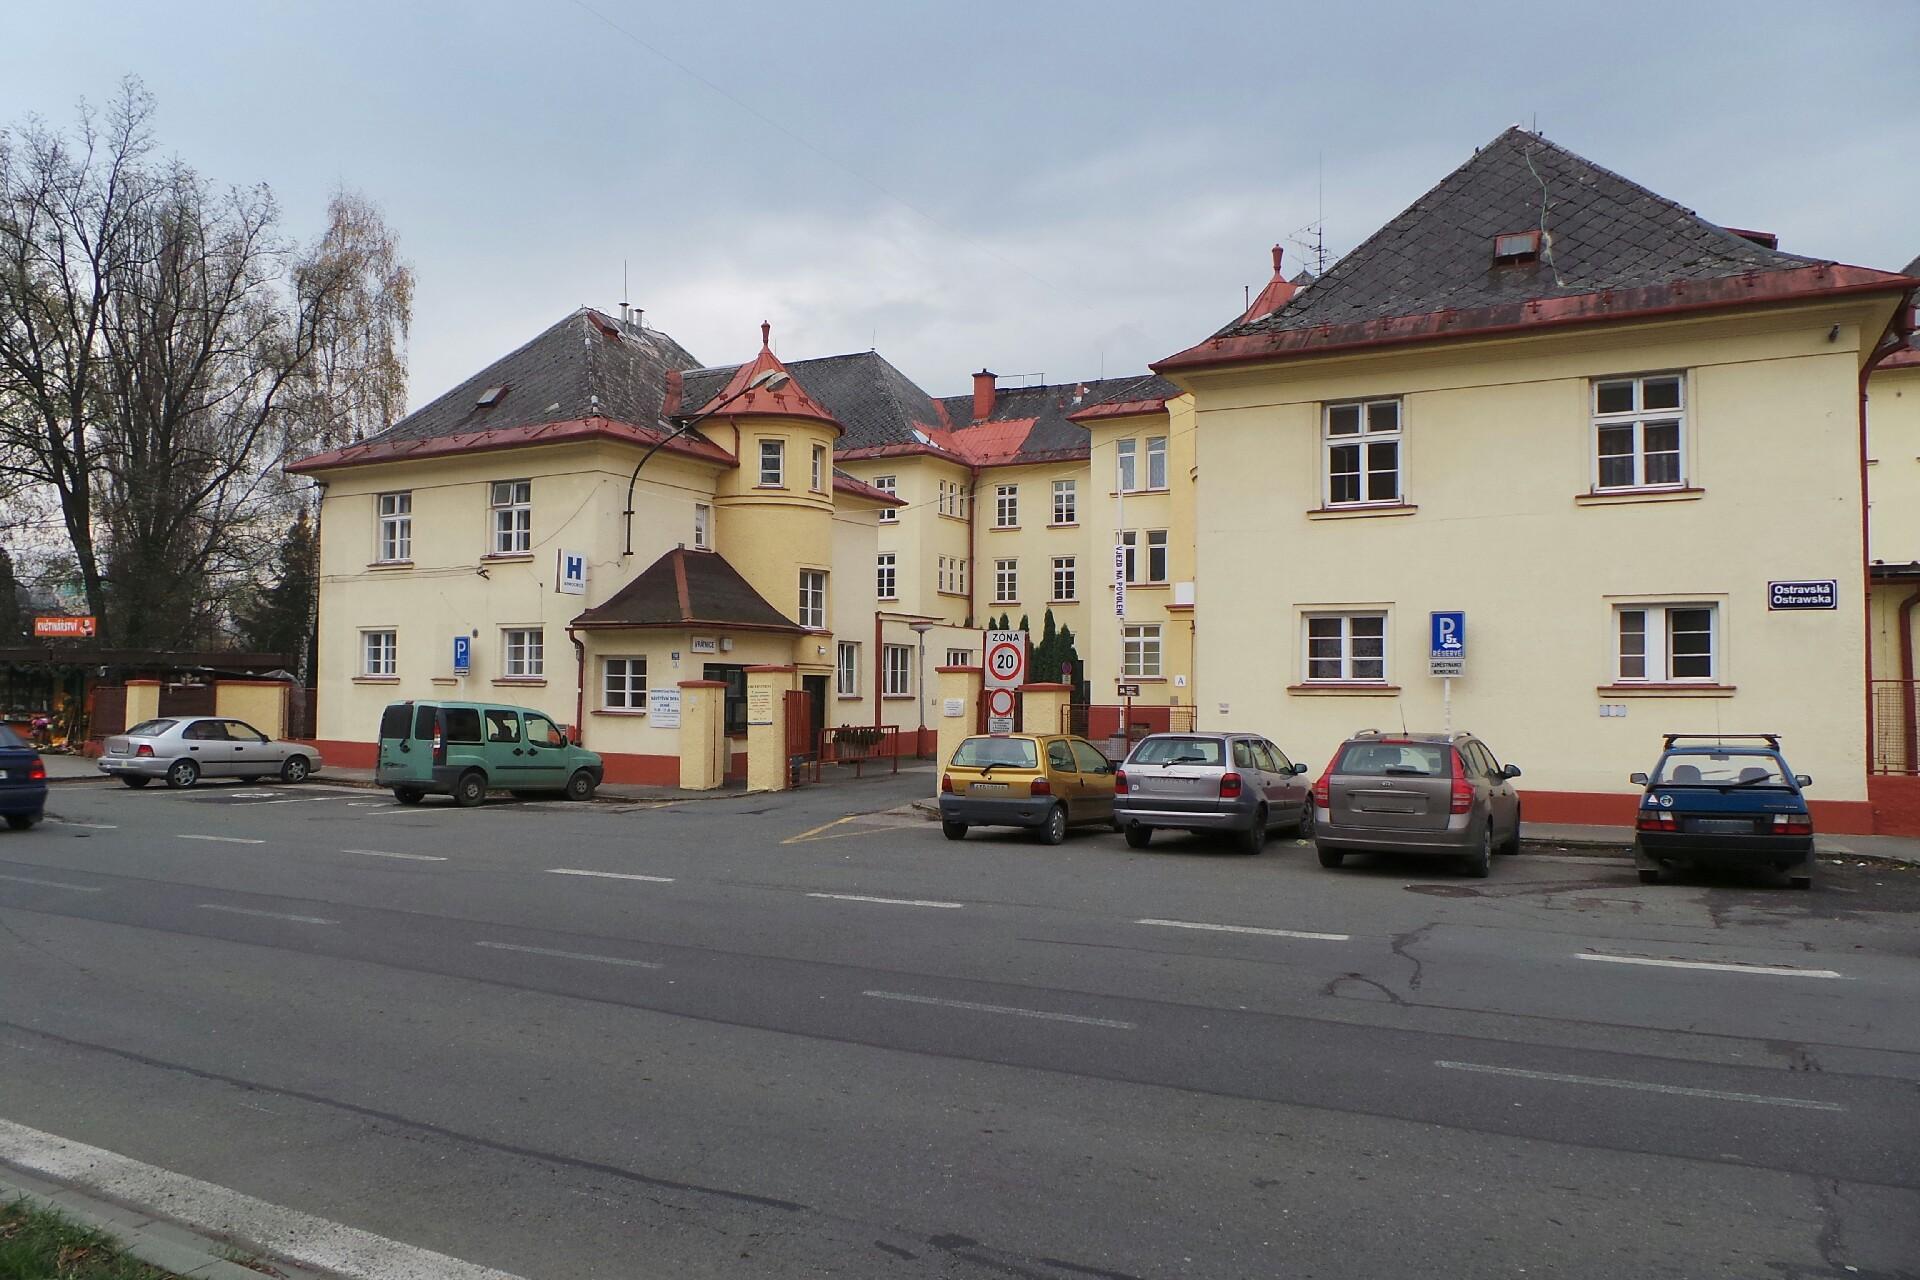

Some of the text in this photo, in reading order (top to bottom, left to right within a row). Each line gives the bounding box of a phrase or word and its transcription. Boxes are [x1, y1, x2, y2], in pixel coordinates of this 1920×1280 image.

[1115, 546, 1123, 568] VJEZD
[567, 556, 582, 580] H
[1115, 570, 1123, 580] NA
[1774, 584, 1830, 595] Ostravská
[1773, 594, 1831, 604] Ostrawska
[992, 631, 1020, 642] ZÓNA
[1440, 618, 1455, 642] P
[457, 640, 466, 659] P
[997, 654, 1014, 669] 20
[1177, 677, 1185, 685] A
